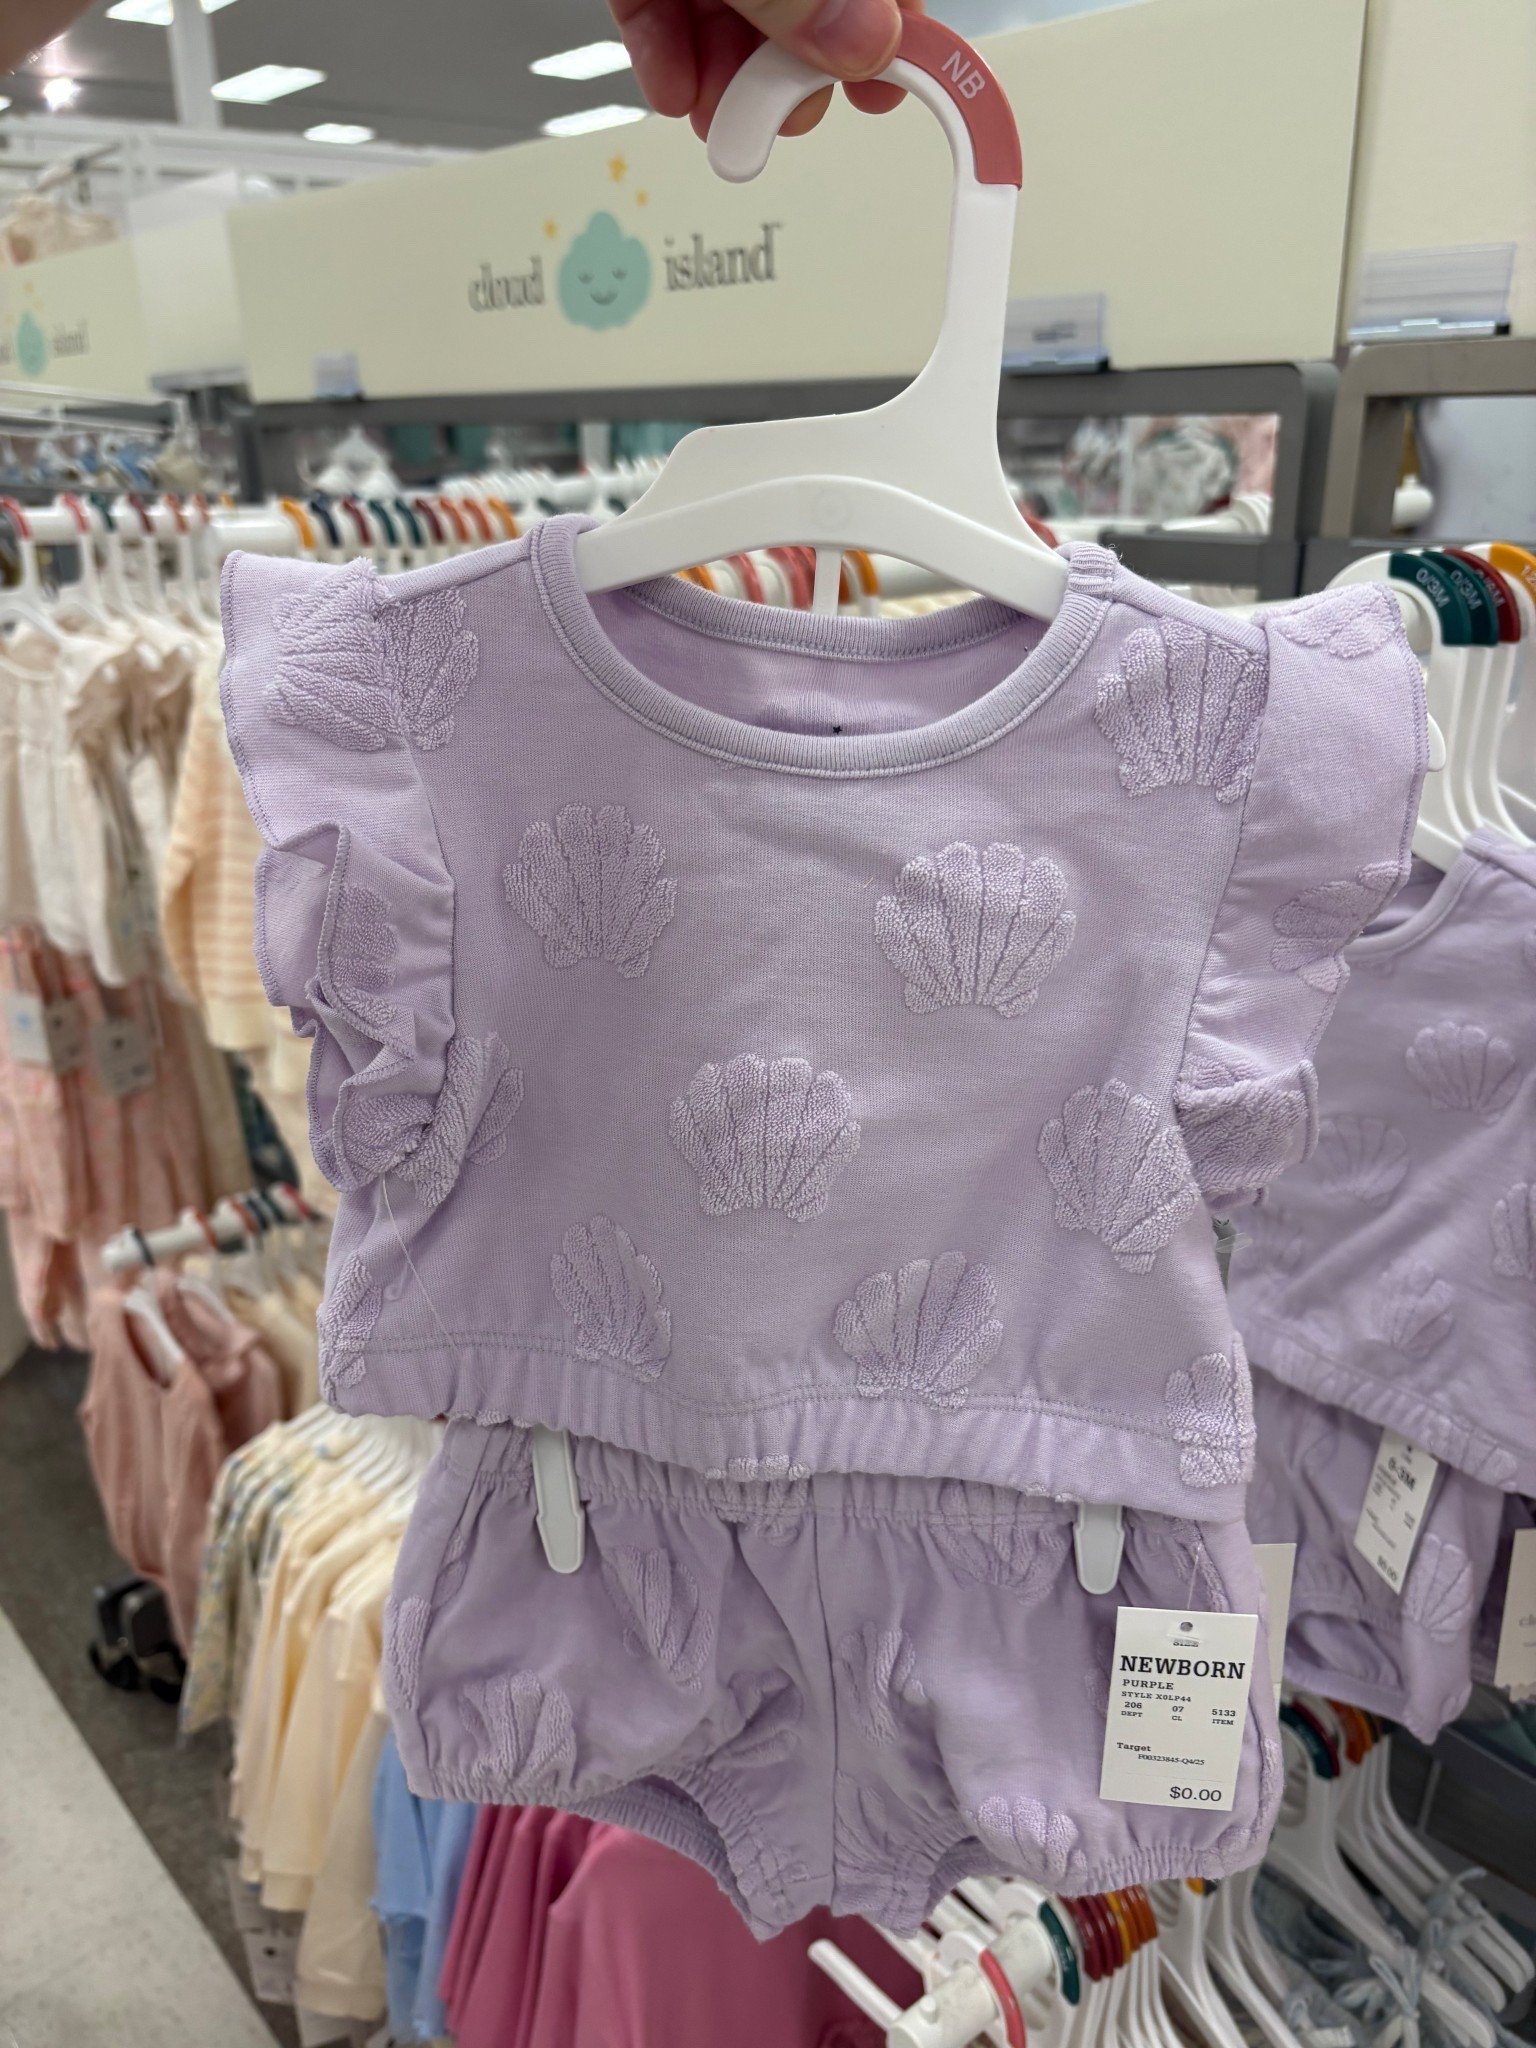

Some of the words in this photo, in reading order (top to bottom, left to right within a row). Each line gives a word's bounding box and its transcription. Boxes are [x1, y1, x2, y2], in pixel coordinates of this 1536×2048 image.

[941, 50, 986, 99] NB
[1416, 568, 1450, 608] 0/3M
[1119, 1655, 1245, 1679] NEWBORN
[1122, 1678, 1174, 1690] PURPLE
[1121, 1691, 1152, 1700] STYLE
[1124, 1701, 1143, 1709] 206
[1171, 1705, 1184, 1713] 07
[1211, 1708, 1236, 1717] 5133
[1121, 1710, 1143, 1718] DEPT
[1212, 1718, 1234, 1726] ITEM
[1116, 1741, 1152, 1752] Target
[1169, 1785, 1222, 1802] $0.00
